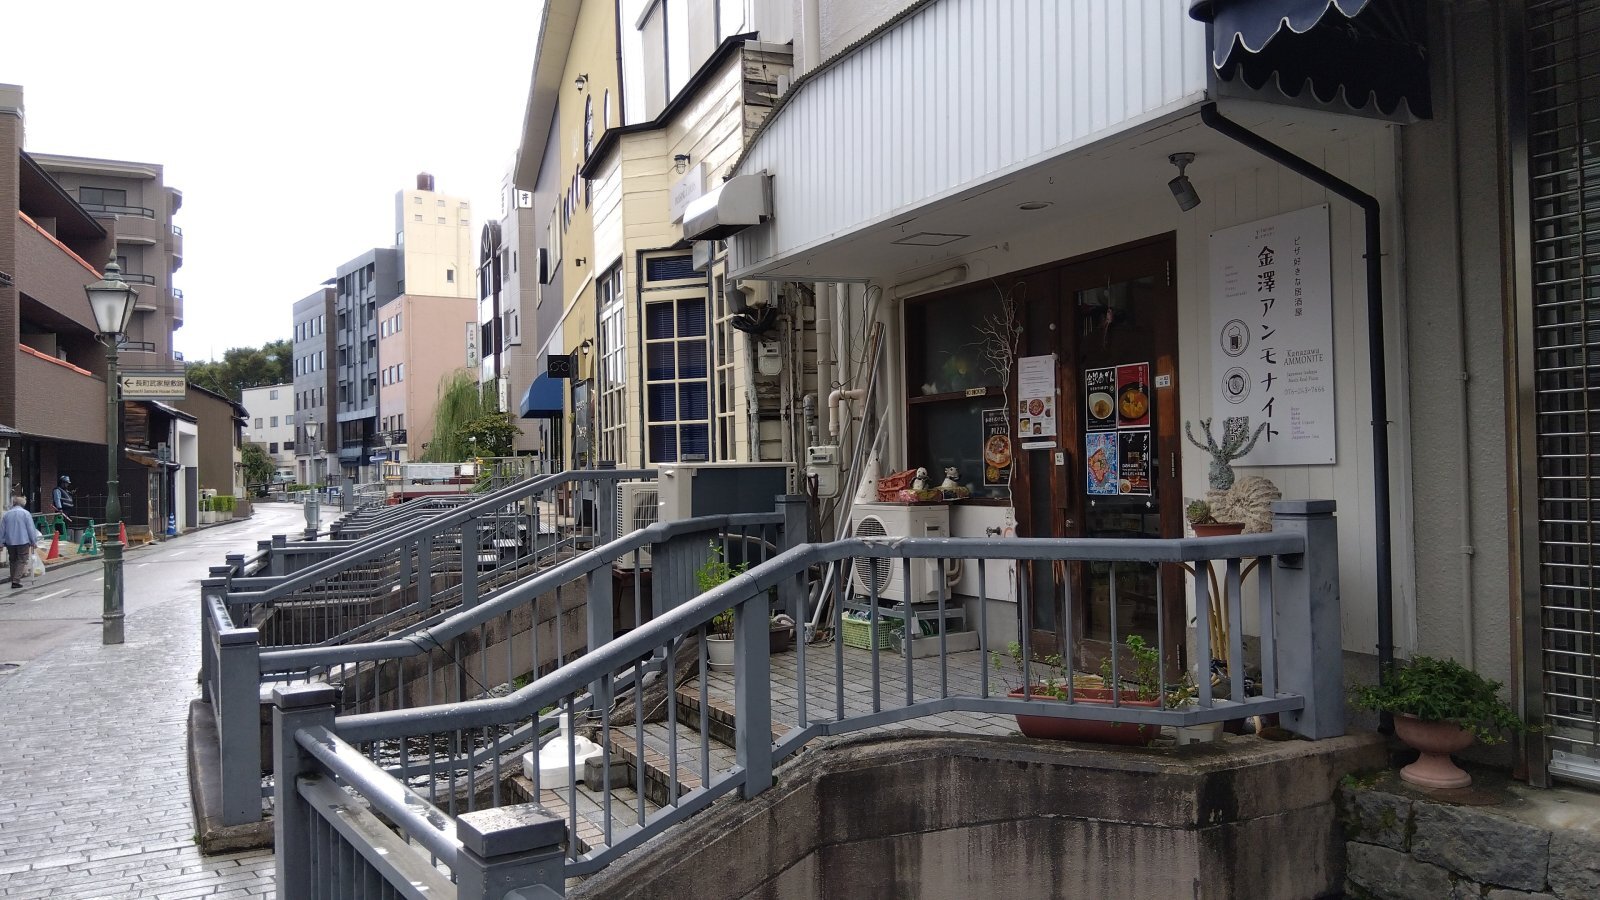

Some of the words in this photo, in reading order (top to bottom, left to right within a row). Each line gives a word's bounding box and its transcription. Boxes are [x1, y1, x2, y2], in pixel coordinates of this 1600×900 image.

[1257, 245, 1279, 443] 金澤アンモナイト
[1287, 348, 1320, 357] Kanazawa
[1283, 354, 1324, 366] AMMONITE
